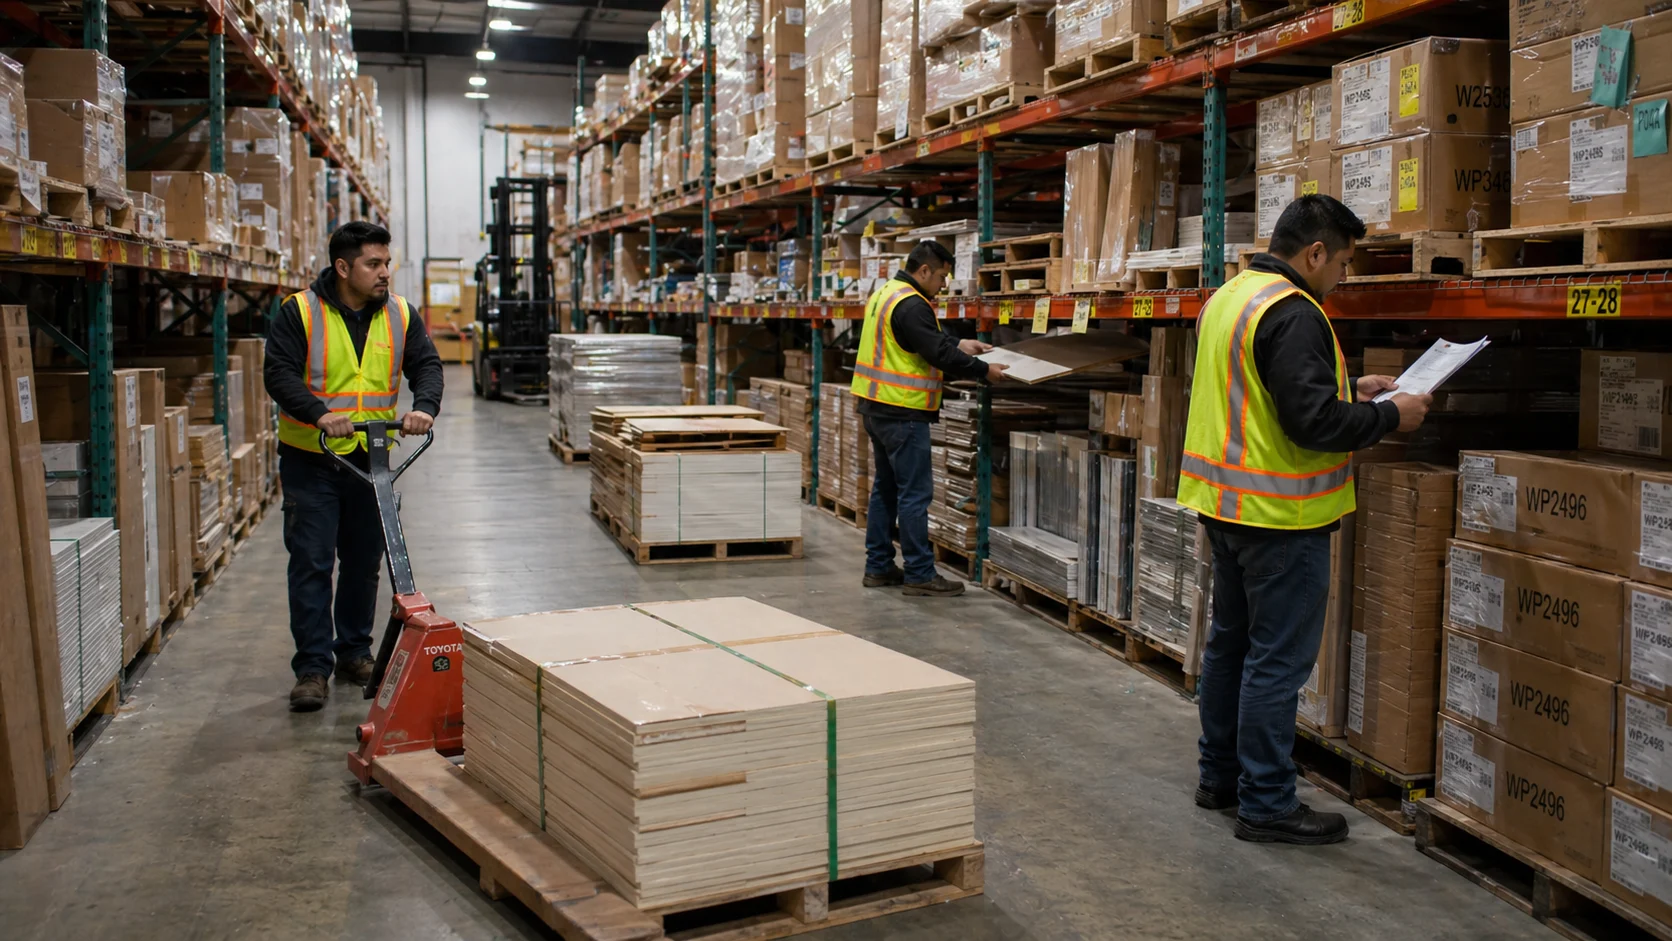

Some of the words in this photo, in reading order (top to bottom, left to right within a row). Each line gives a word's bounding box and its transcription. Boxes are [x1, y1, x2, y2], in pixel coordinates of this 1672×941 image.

[1571, 287, 1617, 314] 27-28
[1526, 485, 1587, 521] WP2496
[1517, 586, 1580, 628] WP2496
[424, 643, 463, 655] TOYOTA
[1510, 680, 1570, 726] WP2496
[1506, 771, 1565, 821] WP2496
